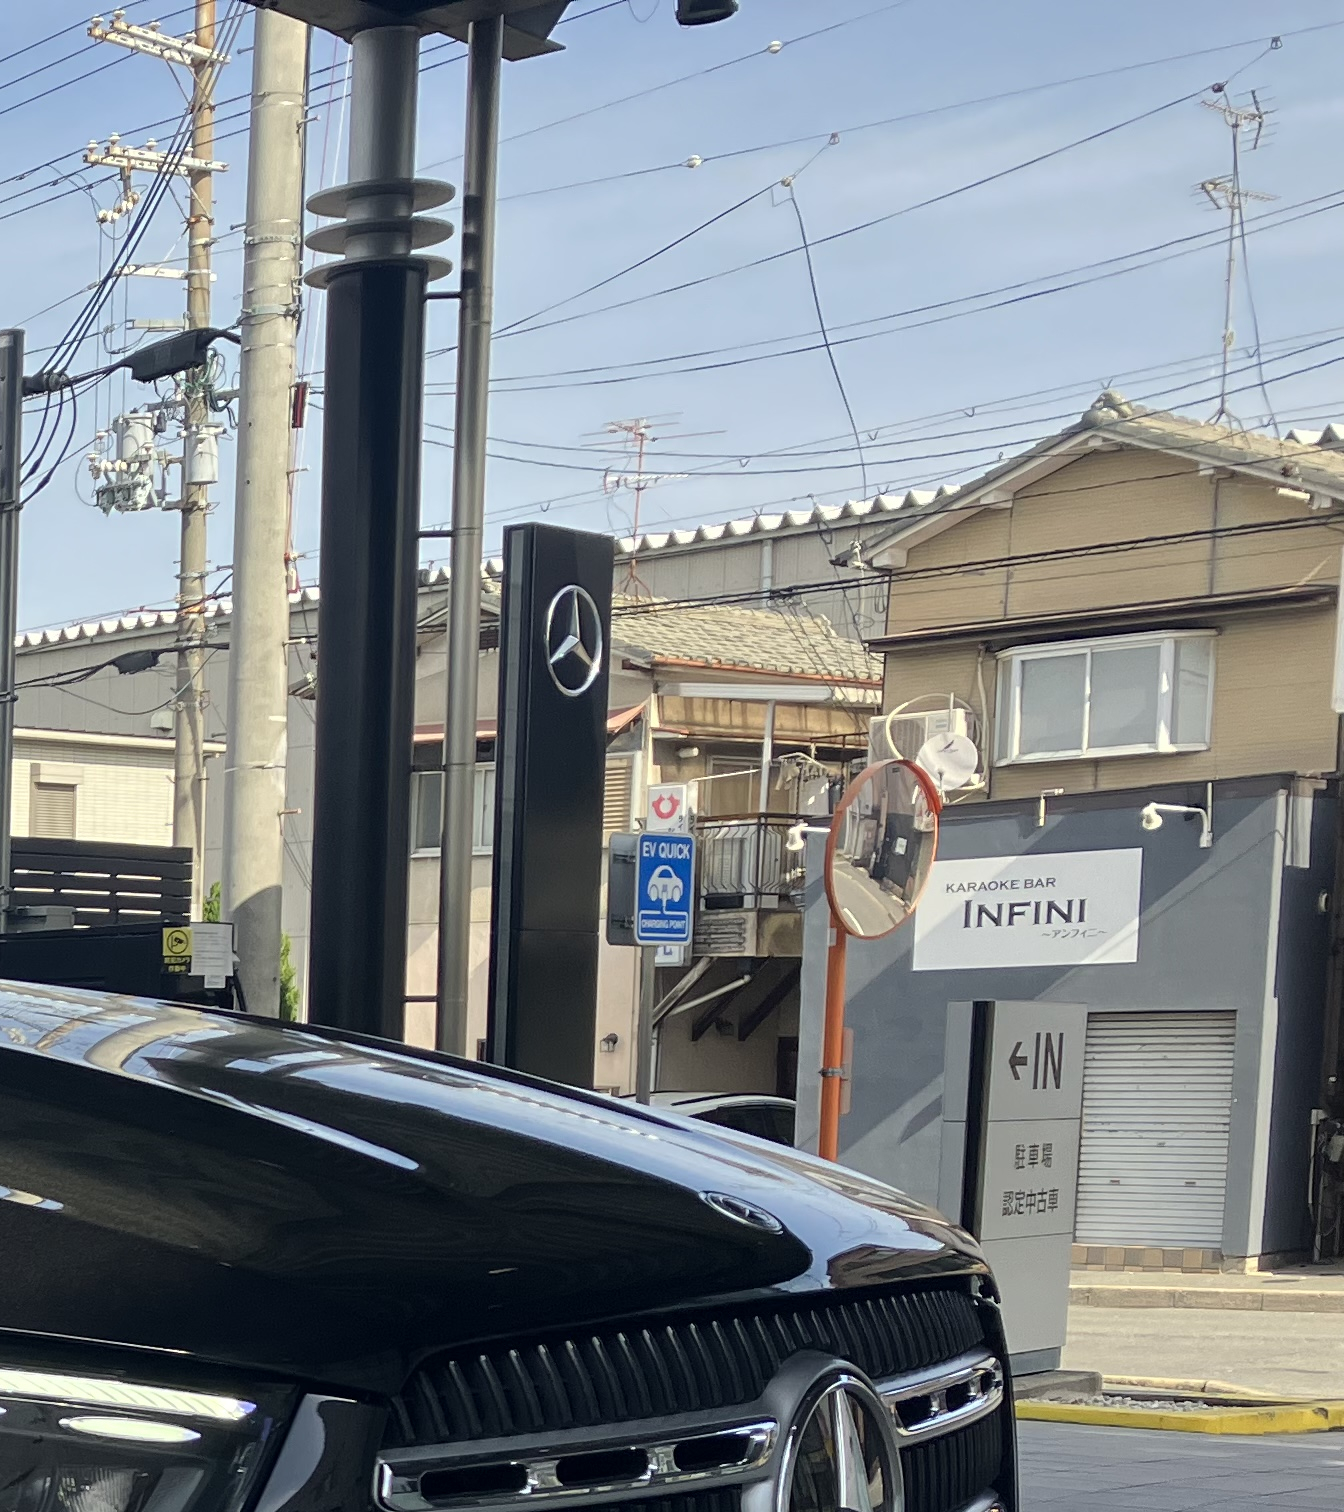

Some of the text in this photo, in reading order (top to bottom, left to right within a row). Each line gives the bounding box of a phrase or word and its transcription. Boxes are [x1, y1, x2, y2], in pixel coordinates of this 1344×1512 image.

[642, 841, 692, 860] EV QUICK
[946, 877, 1057, 894] KARAOKE BAR
[963, 898, 1088, 929] INFINI
[1032, 1032, 1065, 1090] IN
[1014, 1142, 1053, 1170] 駐車場
[1002, 1187, 1060, 1217] 認定中古車
